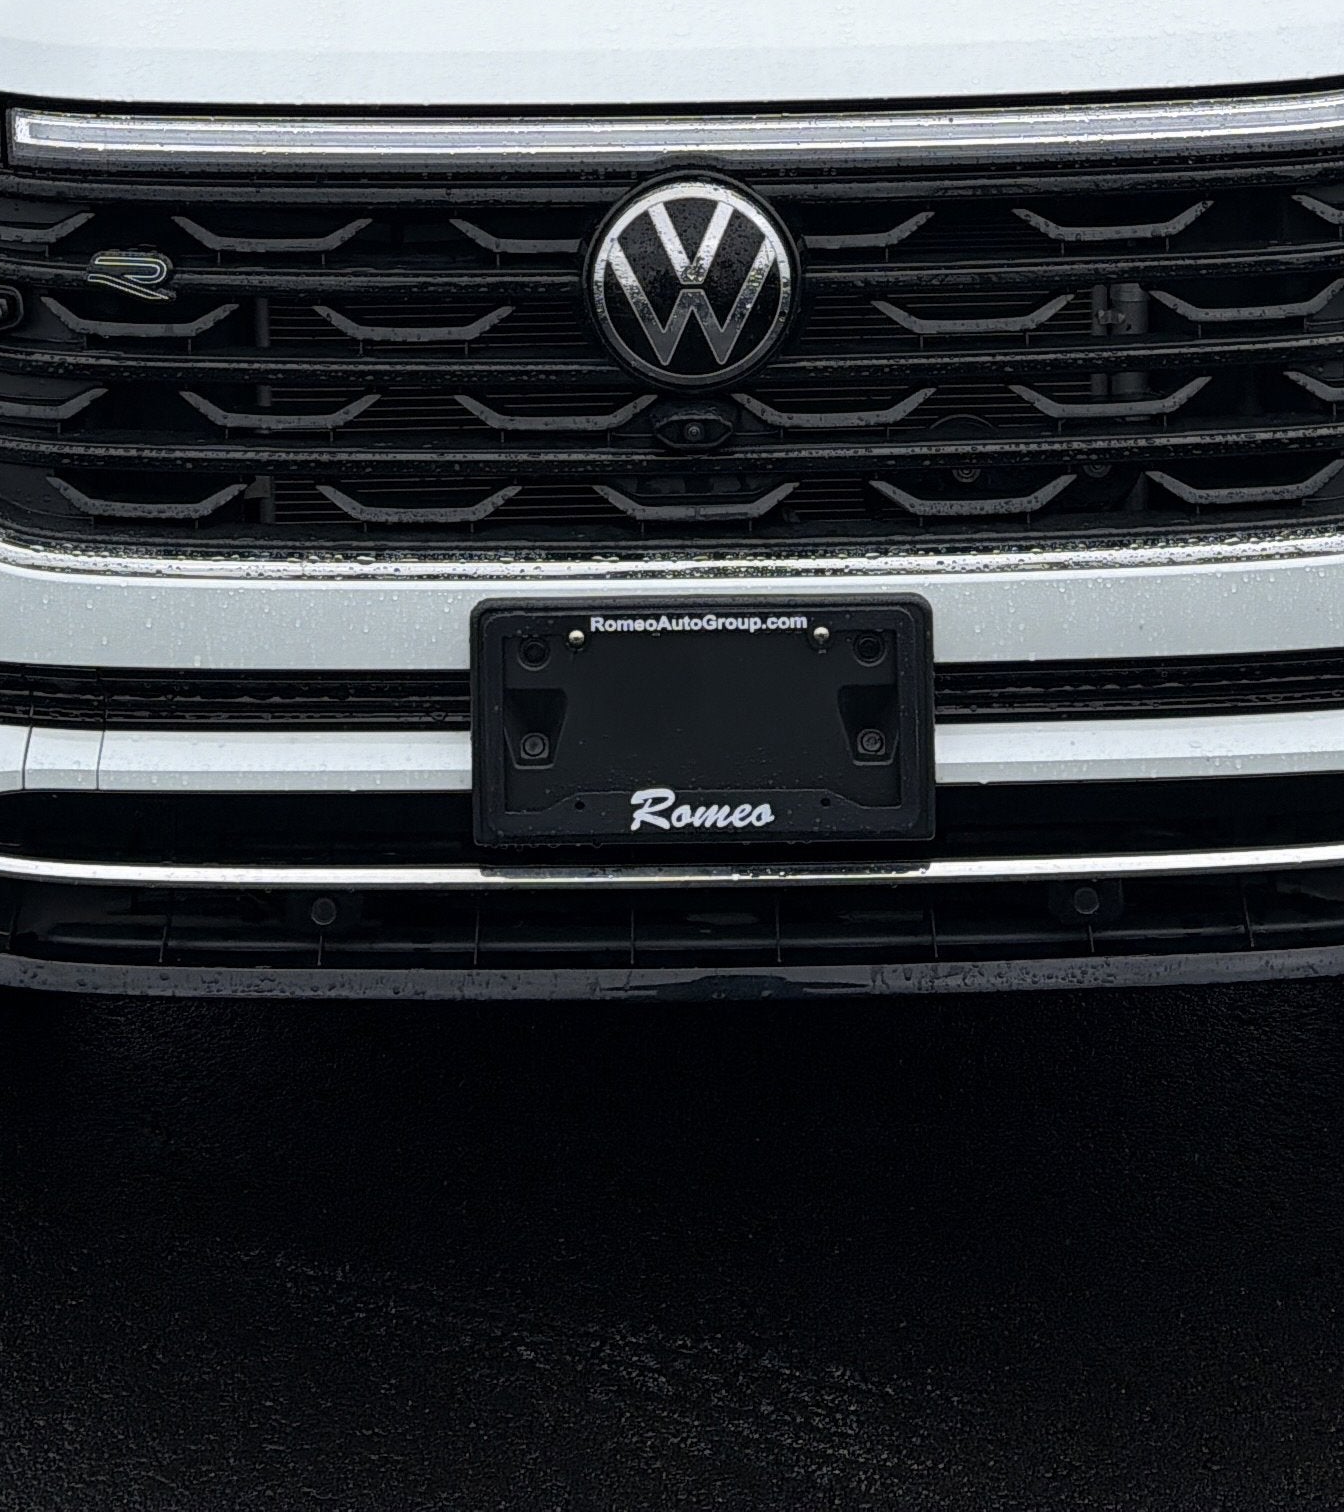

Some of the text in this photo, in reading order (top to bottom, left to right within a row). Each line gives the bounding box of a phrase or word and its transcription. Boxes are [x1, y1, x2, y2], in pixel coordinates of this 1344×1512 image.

[606, 199, 777, 367] VW
[590, 614, 808, 633] RomeoAutoGroup.com
[630, 788, 775, 831] Romeo
